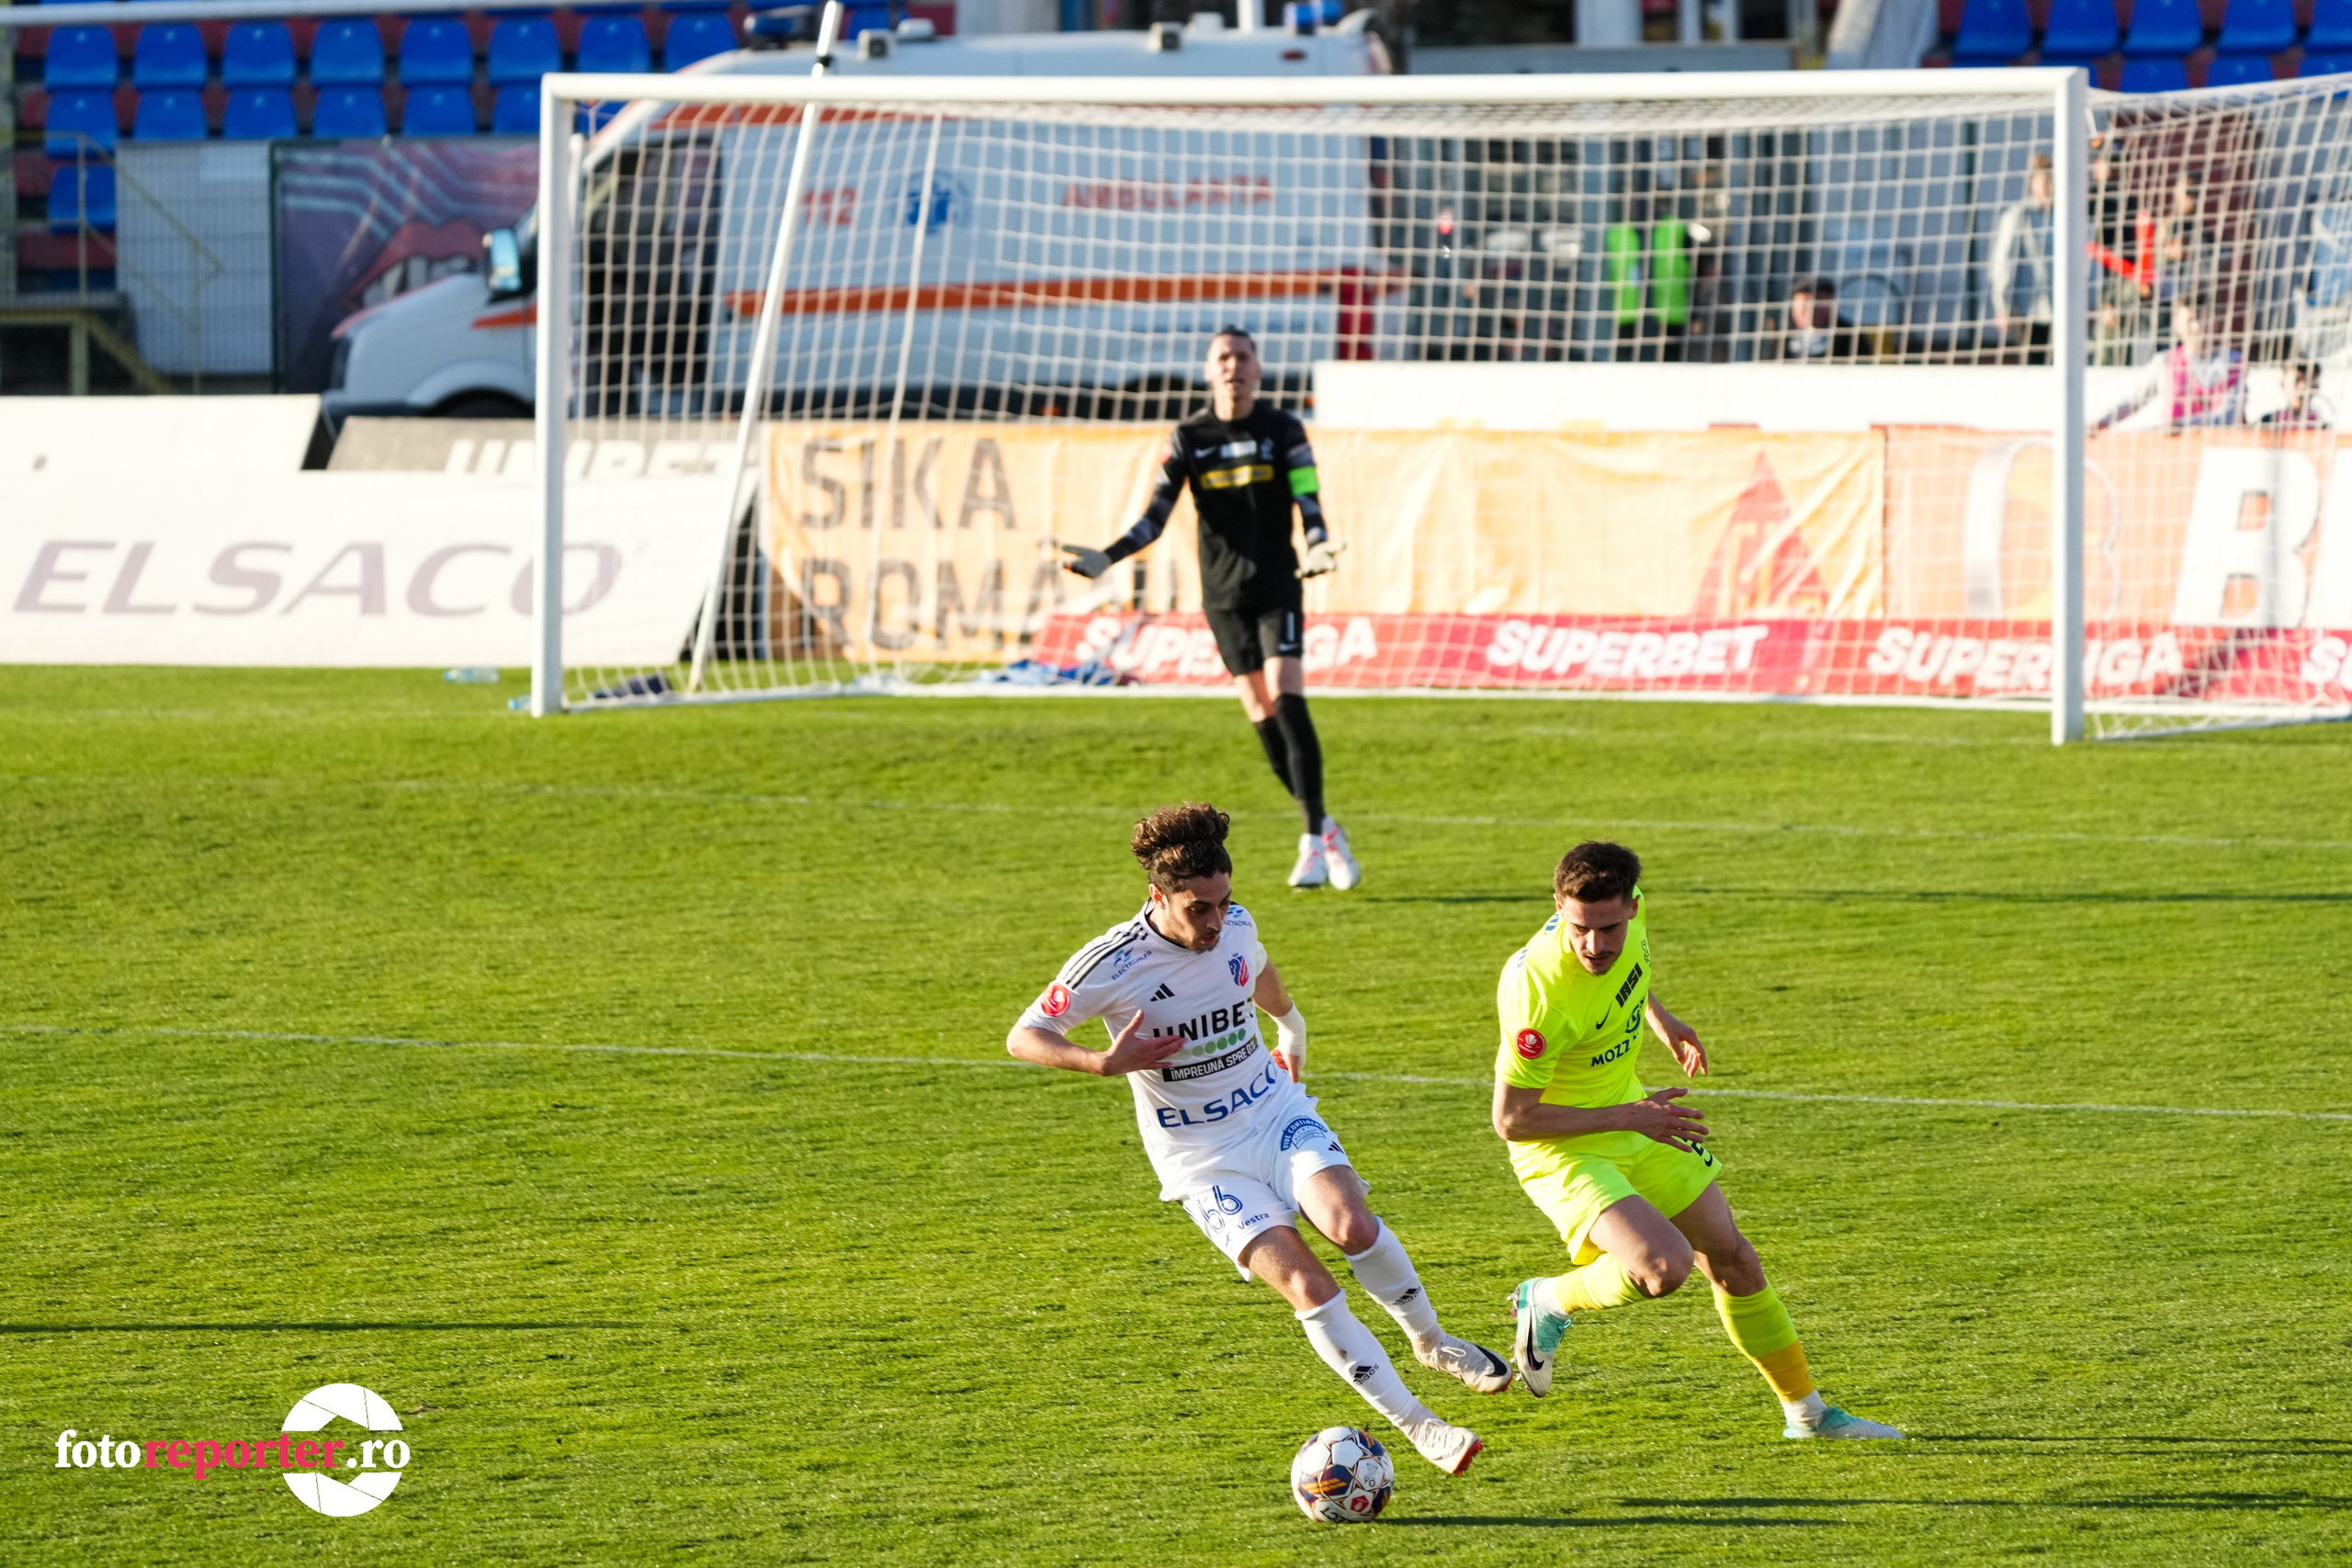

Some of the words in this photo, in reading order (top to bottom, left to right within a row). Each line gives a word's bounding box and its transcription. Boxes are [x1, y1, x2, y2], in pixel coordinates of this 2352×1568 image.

[802, 186, 857, 226] 112
[801, 436, 1017, 530] SIKA
[13, 539, 623, 617] ELSACO
[1075, 616, 1378, 677] SUPEGA
[1485, 619, 1769, 678] SUPERBET
[1867, 626, 2184, 692] SUPERIGA
[2300, 636, 2352, 693] S
[1170, 1057, 1225, 1081] ÎMPREUNĂ
[1226, 1047, 1248, 1067] SPRE
[1156, 1060, 1276, 1129] ELSACO
[1197, 1184, 1243, 1234] 66
